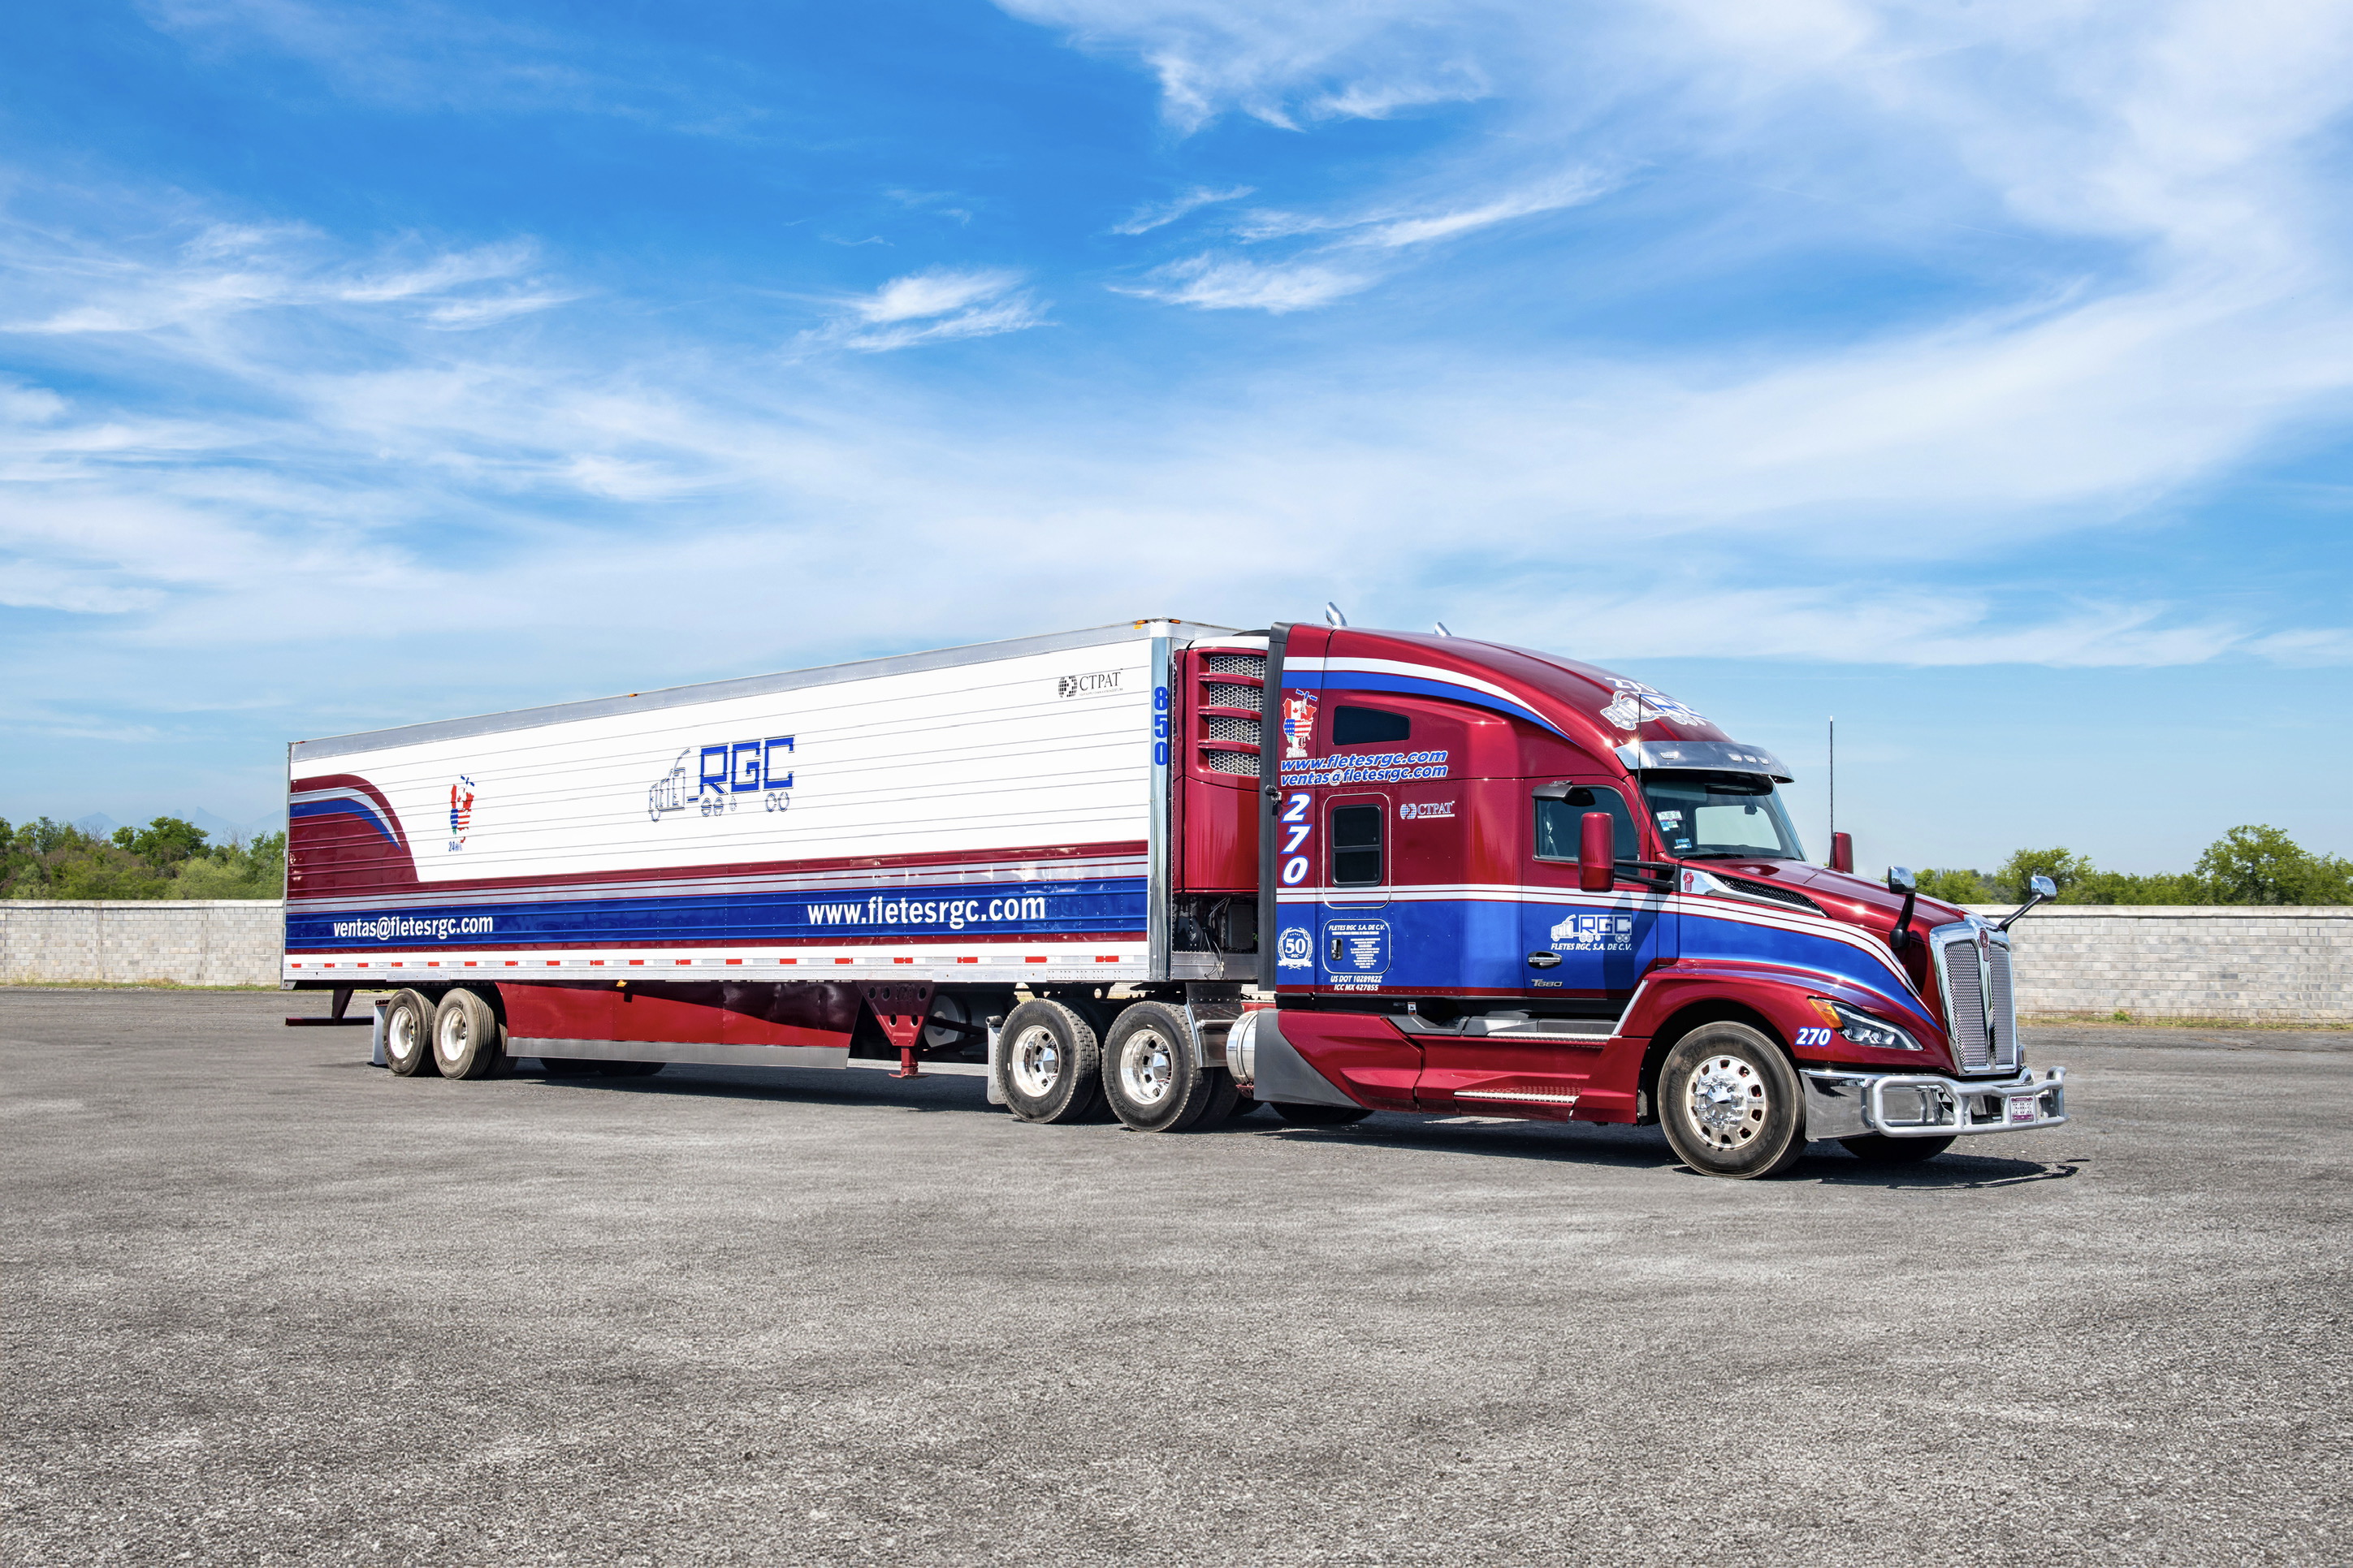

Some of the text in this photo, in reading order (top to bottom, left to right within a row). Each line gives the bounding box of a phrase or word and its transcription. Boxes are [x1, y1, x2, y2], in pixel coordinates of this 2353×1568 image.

[1079, 672, 1121, 691] CTPAT
[1154, 686, 1168, 765] 850
[699, 734, 795, 796] RGC
[1280, 750, 1448, 771] www.fletesrgc.com
[1280, 765, 1448, 786] ventas@fletesrgc.com
[1417, 802, 1453, 815] CTPAT
[1280, 793, 1313, 886] 270
[807, 896, 1046, 930] www.fletesrgc.com
[333, 916, 494, 940] ventas@fletesrgc.com
[1579, 914, 1632, 935] RGC
[1285, 938, 1306, 954] 50
[1551, 943, 1632, 951] FLETES RGC, S.A. DE C.V.
[1356, 983, 1379, 991] 427855
[1531, 978, 1563, 987] T680
[1795, 1026, 1832, 1047] 270
